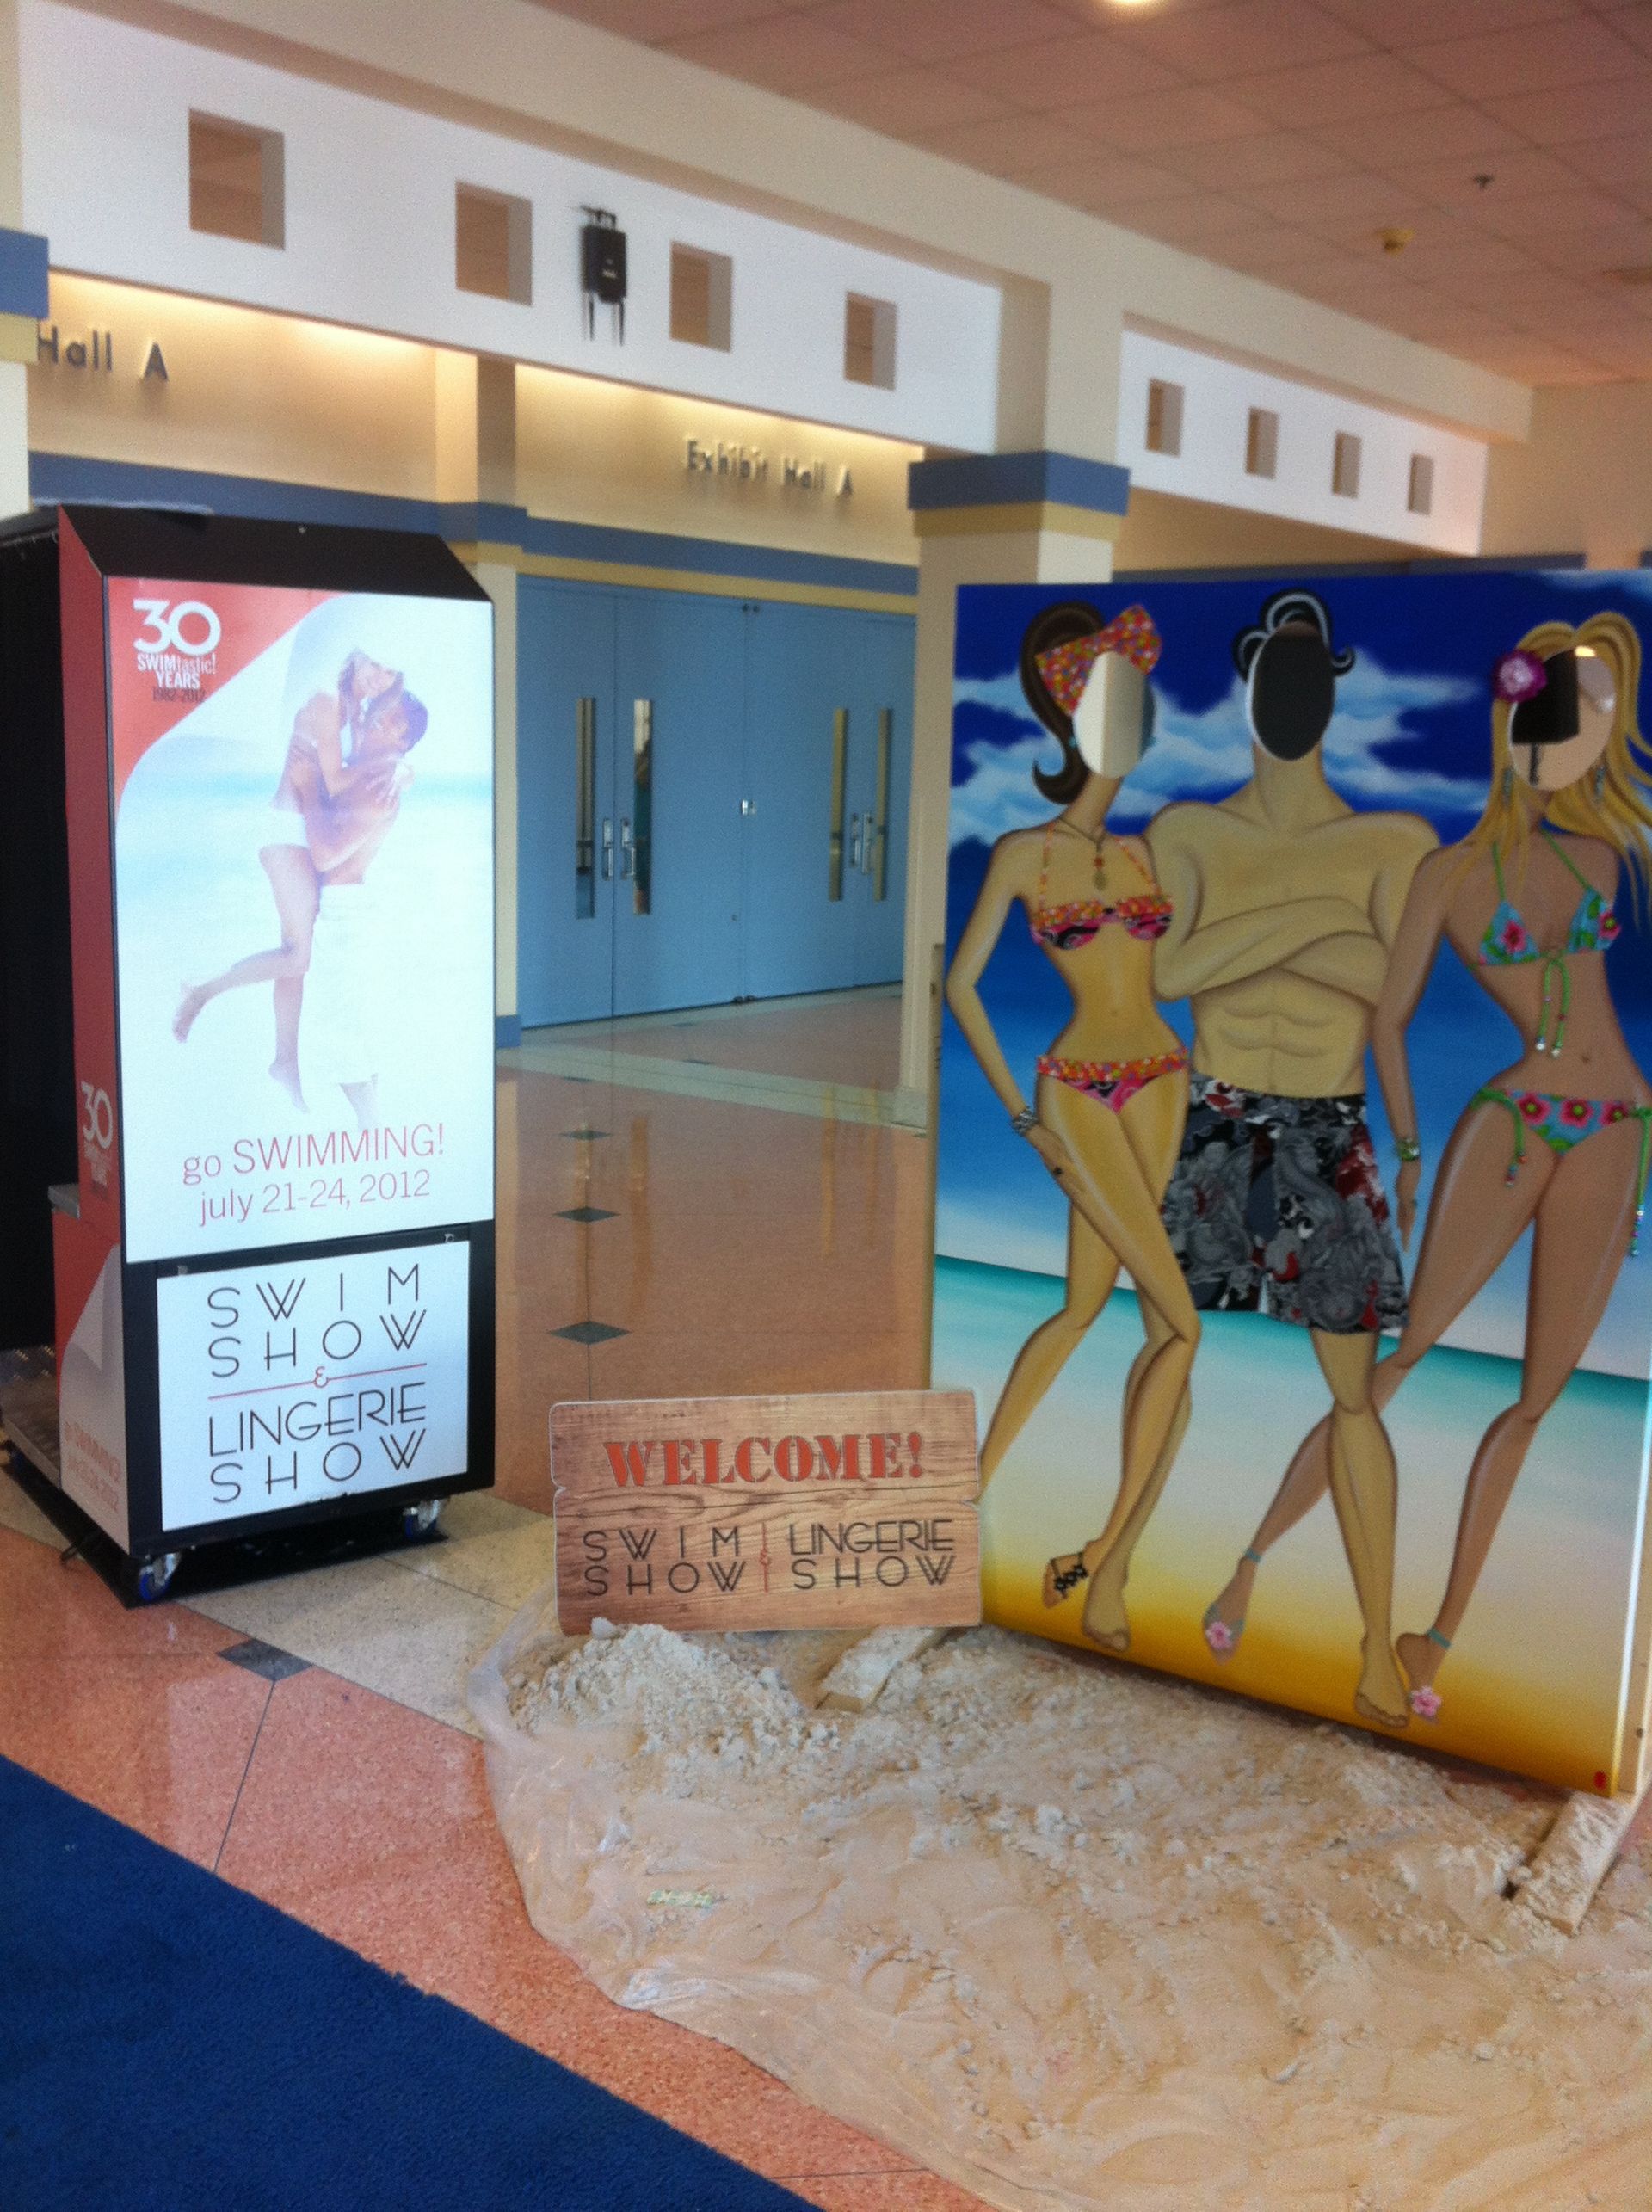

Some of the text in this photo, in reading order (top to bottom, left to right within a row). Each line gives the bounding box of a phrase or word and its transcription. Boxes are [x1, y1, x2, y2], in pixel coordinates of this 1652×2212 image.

[38, 324, 169, 380] Hall A
[835, 469, 854, 496] A
[133, 598, 222, 657] 30
[155, 669, 202, 690] YEARS
[81, 1081, 114, 1149] 30
[182, 1122, 445, 1186] go SWIMMING!
[199, 1168, 431, 1227] july 21-24, 2012
[207, 1263, 420, 1328] SWIM
[207, 1308, 427, 1378] SHOW
[208, 1381, 427, 1457] LINGERIE
[210, 1427, 427, 1504] SHOW
[604, 1431, 923, 1488] WELCOME!
[582, 1525, 742, 1562] SWIM
[788, 1519, 954, 1557] LINGERIE
[583, 1560, 746, 1597] SHOW
[791, 1554, 957, 1591] SHOW
